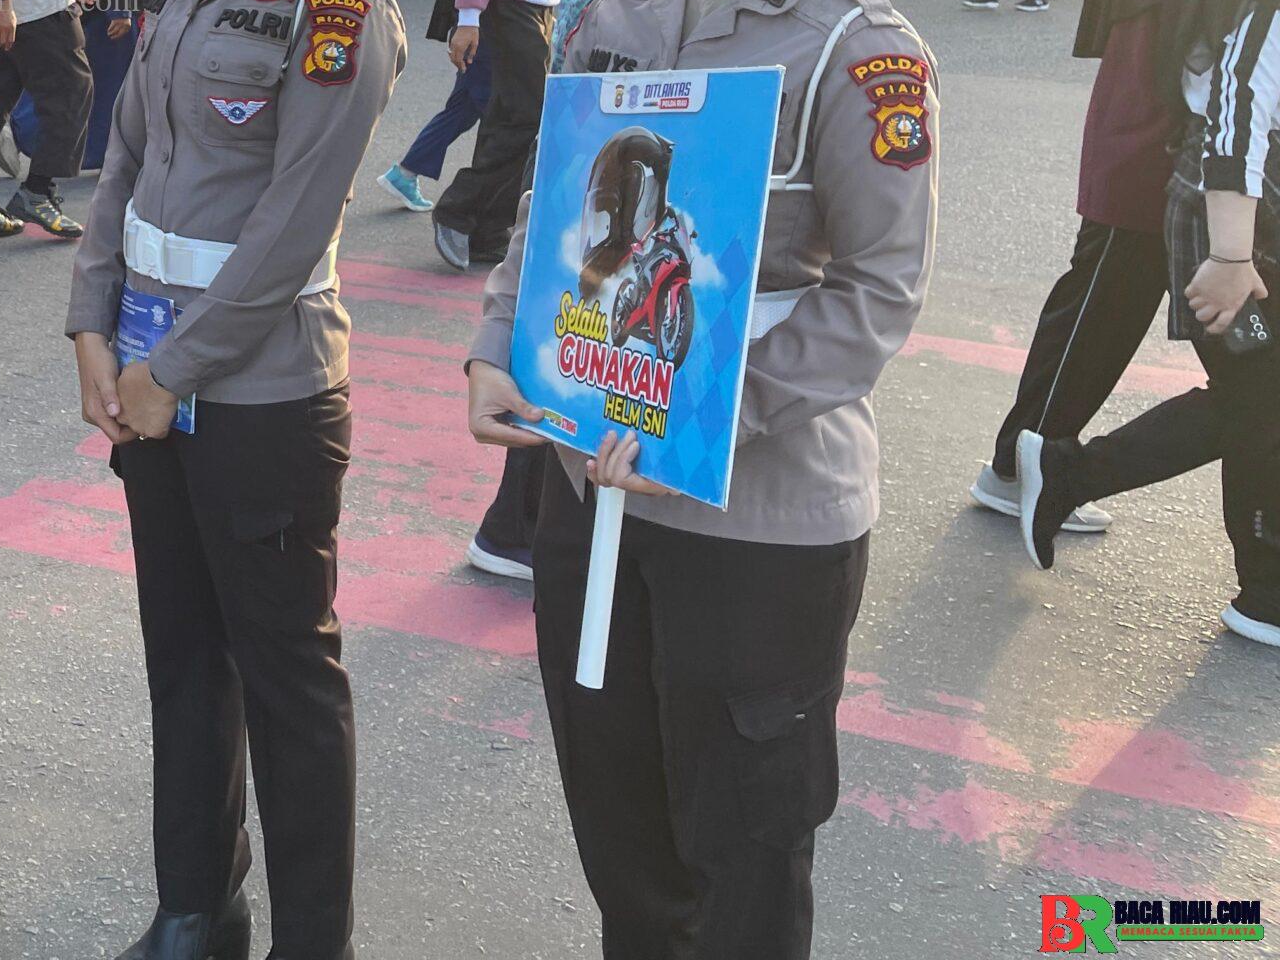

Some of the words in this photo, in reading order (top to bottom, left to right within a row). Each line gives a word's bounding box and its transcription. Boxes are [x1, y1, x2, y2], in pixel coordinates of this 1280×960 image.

[214, 7, 292, 40] POLRI
[315, 15, 356, 28] RIAU
[854, 57, 923, 80] POLDA
[644, 82, 691, 98] DITLANTAS
[874, 83, 921, 97] RIAU
[555, 291, 608, 342] Selalu
[558, 334, 674, 410] GUNAKAN
[604, 394, 643, 430] HELM
[642, 407, 668, 439] SNI
